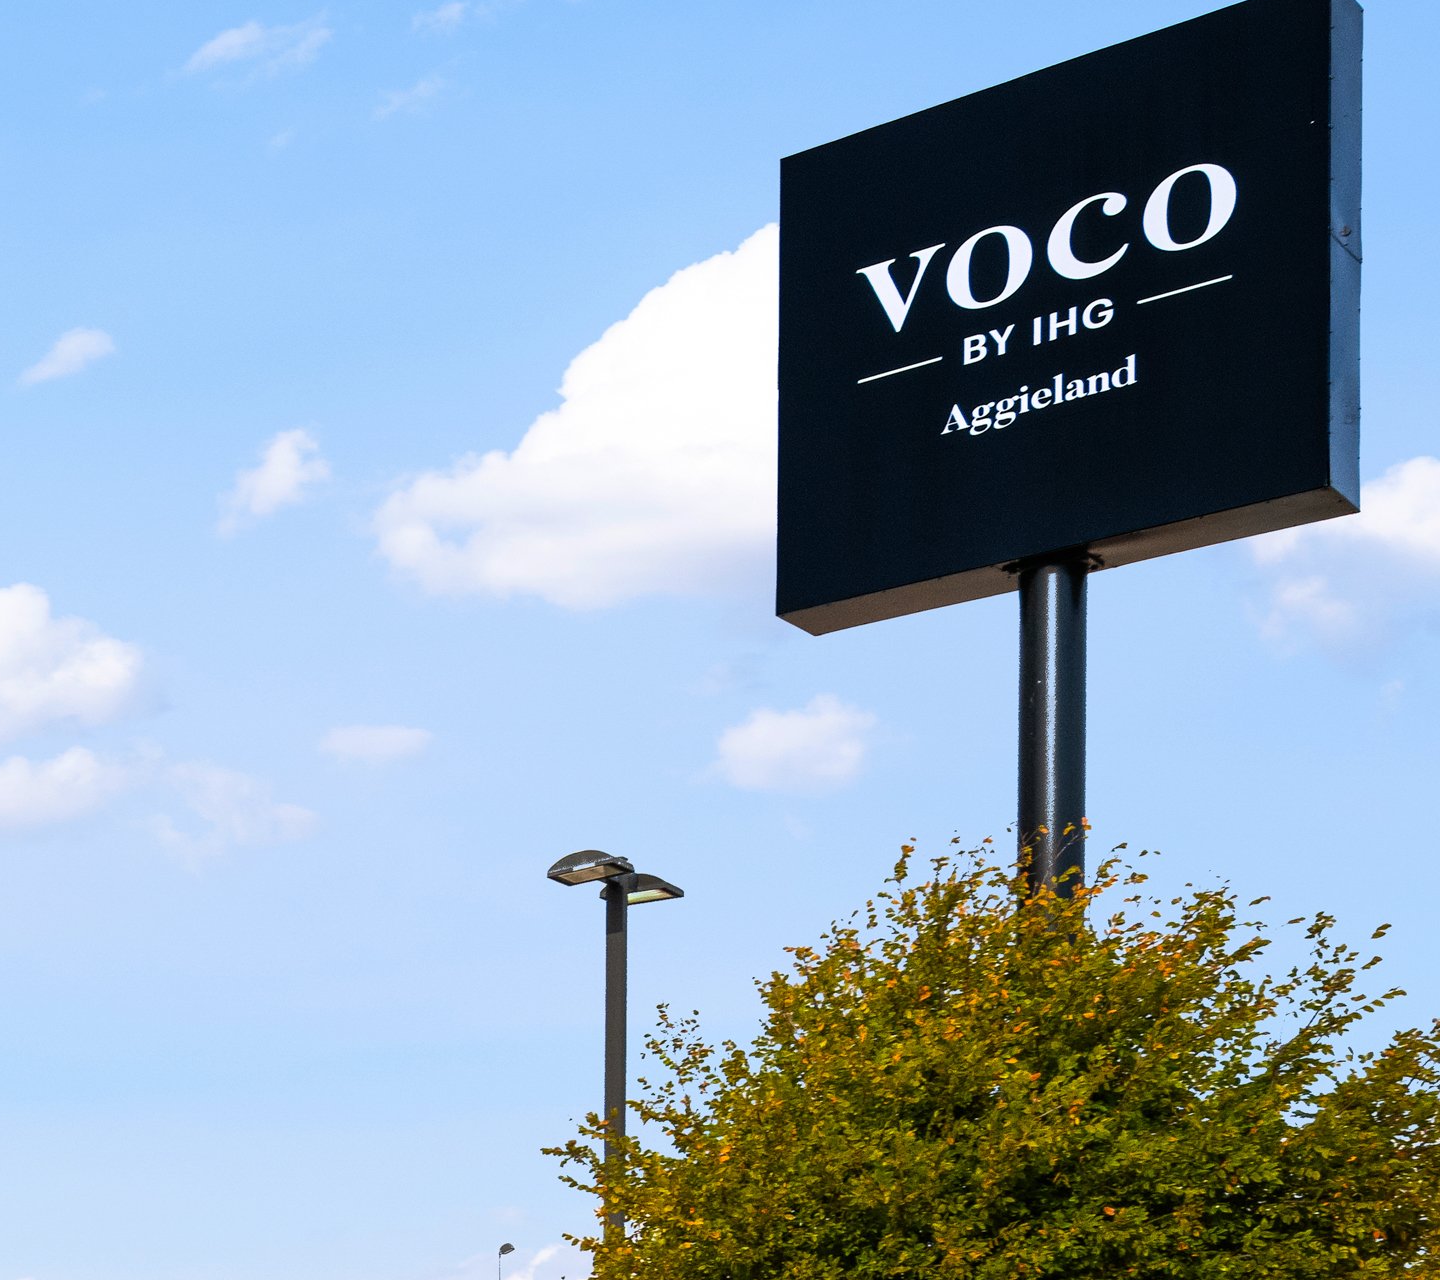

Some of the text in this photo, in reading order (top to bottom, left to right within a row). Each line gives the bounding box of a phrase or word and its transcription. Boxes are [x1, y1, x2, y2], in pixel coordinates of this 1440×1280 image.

[963, 298, 1114, 366] BY IHG
[940, 353, 1138, 436] Aggieland
